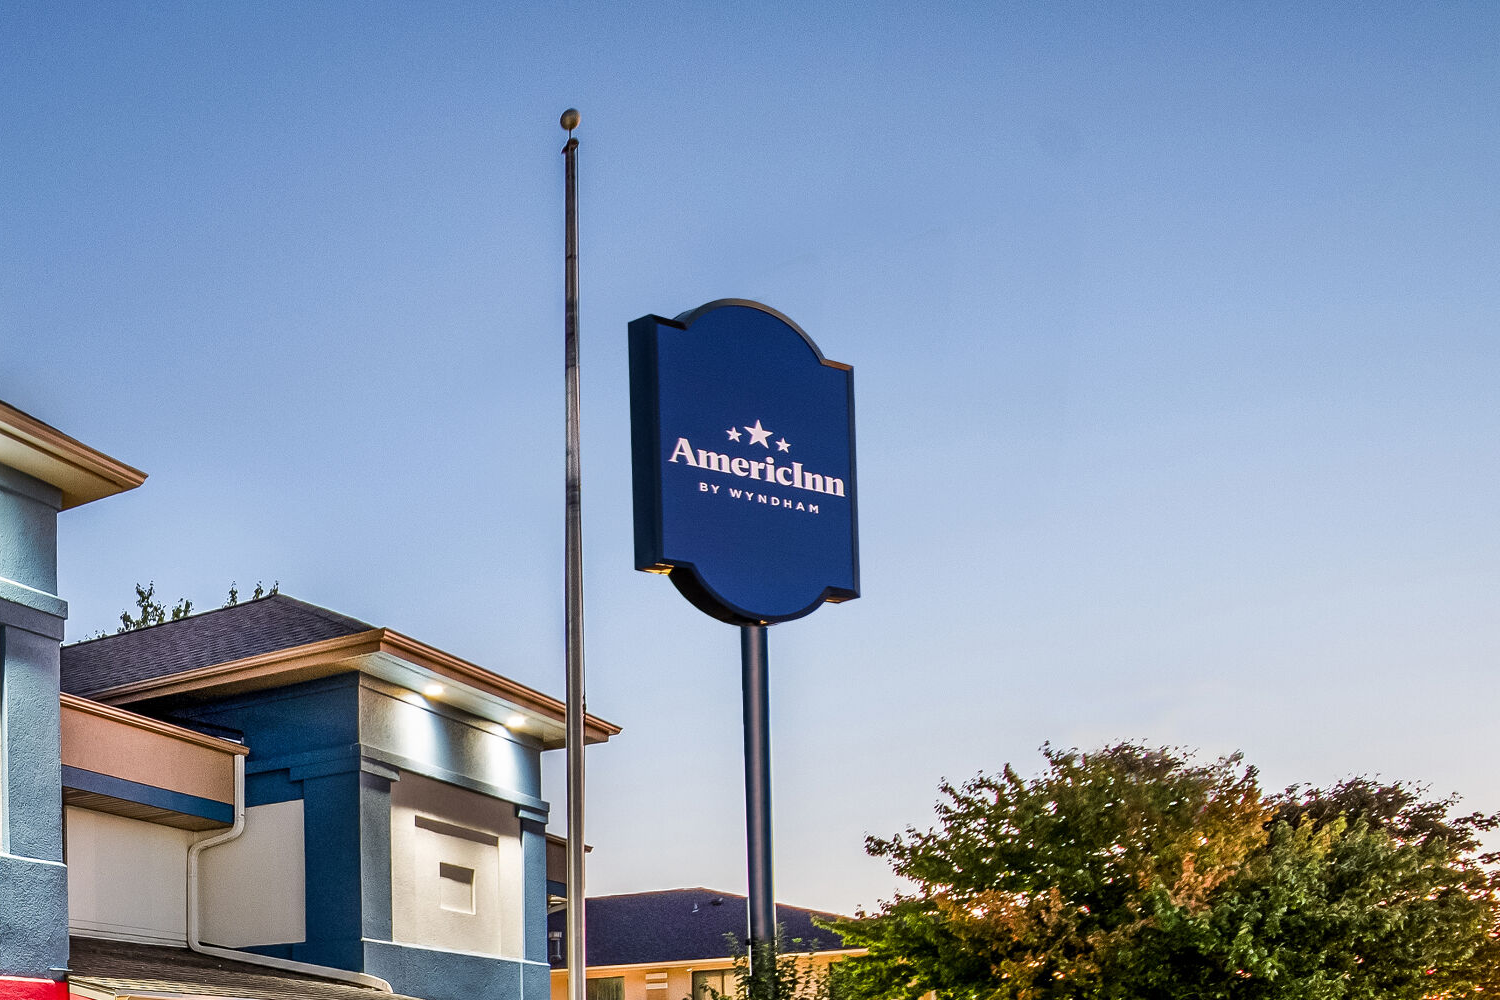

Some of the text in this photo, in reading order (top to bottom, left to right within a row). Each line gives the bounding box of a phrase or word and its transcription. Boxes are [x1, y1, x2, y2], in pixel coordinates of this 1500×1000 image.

[669, 437, 846, 498] AmericInn
[699, 482, 819, 514] BY WYNDHAM
